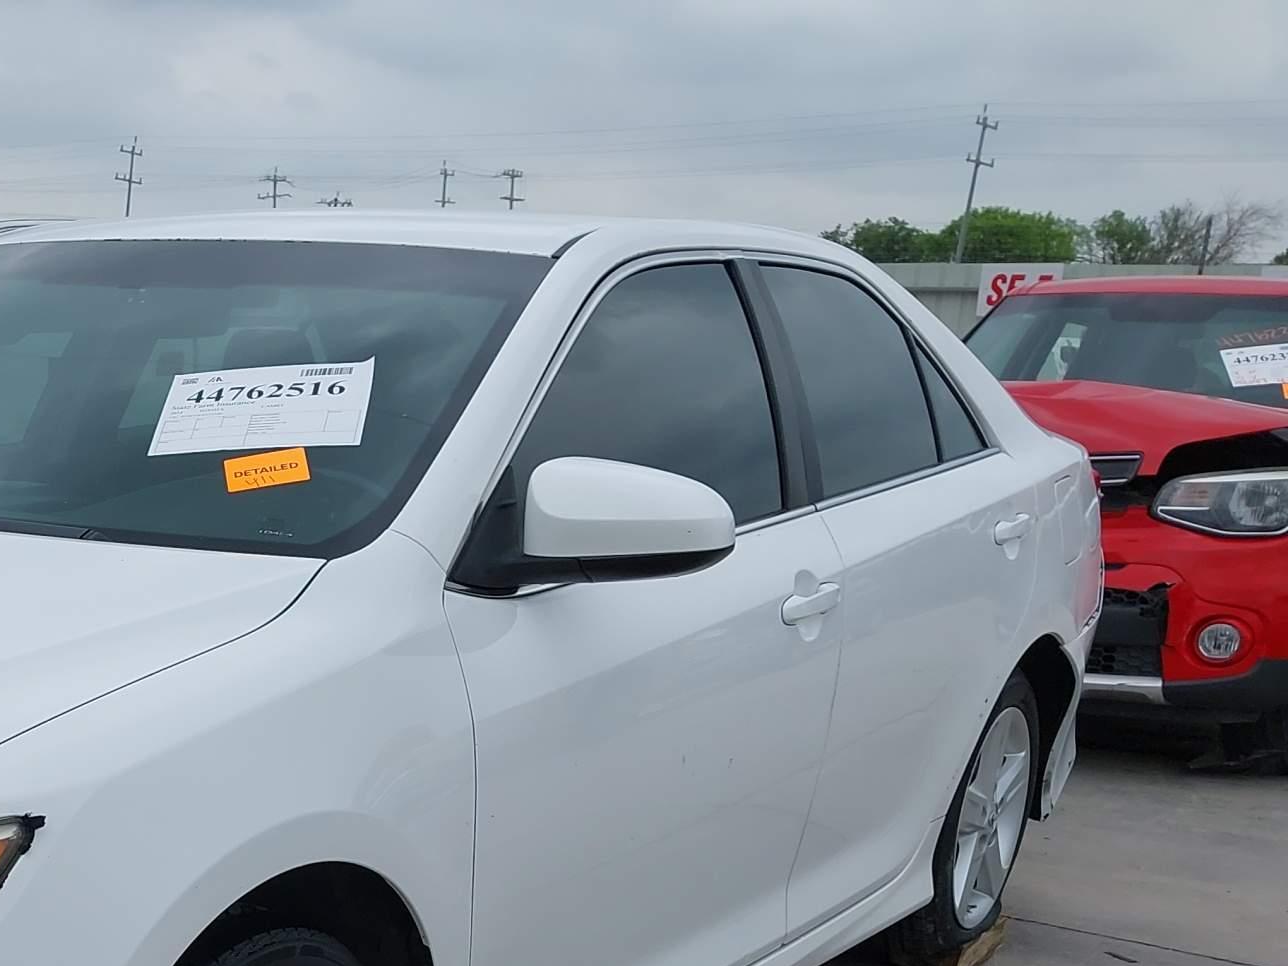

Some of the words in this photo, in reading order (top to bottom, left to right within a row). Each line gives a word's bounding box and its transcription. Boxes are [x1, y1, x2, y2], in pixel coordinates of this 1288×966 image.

[1234, 353, 1288, 364] 447623
[186, 380, 346, 403] 44762516
[233, 462, 299, 479] DETAILED
